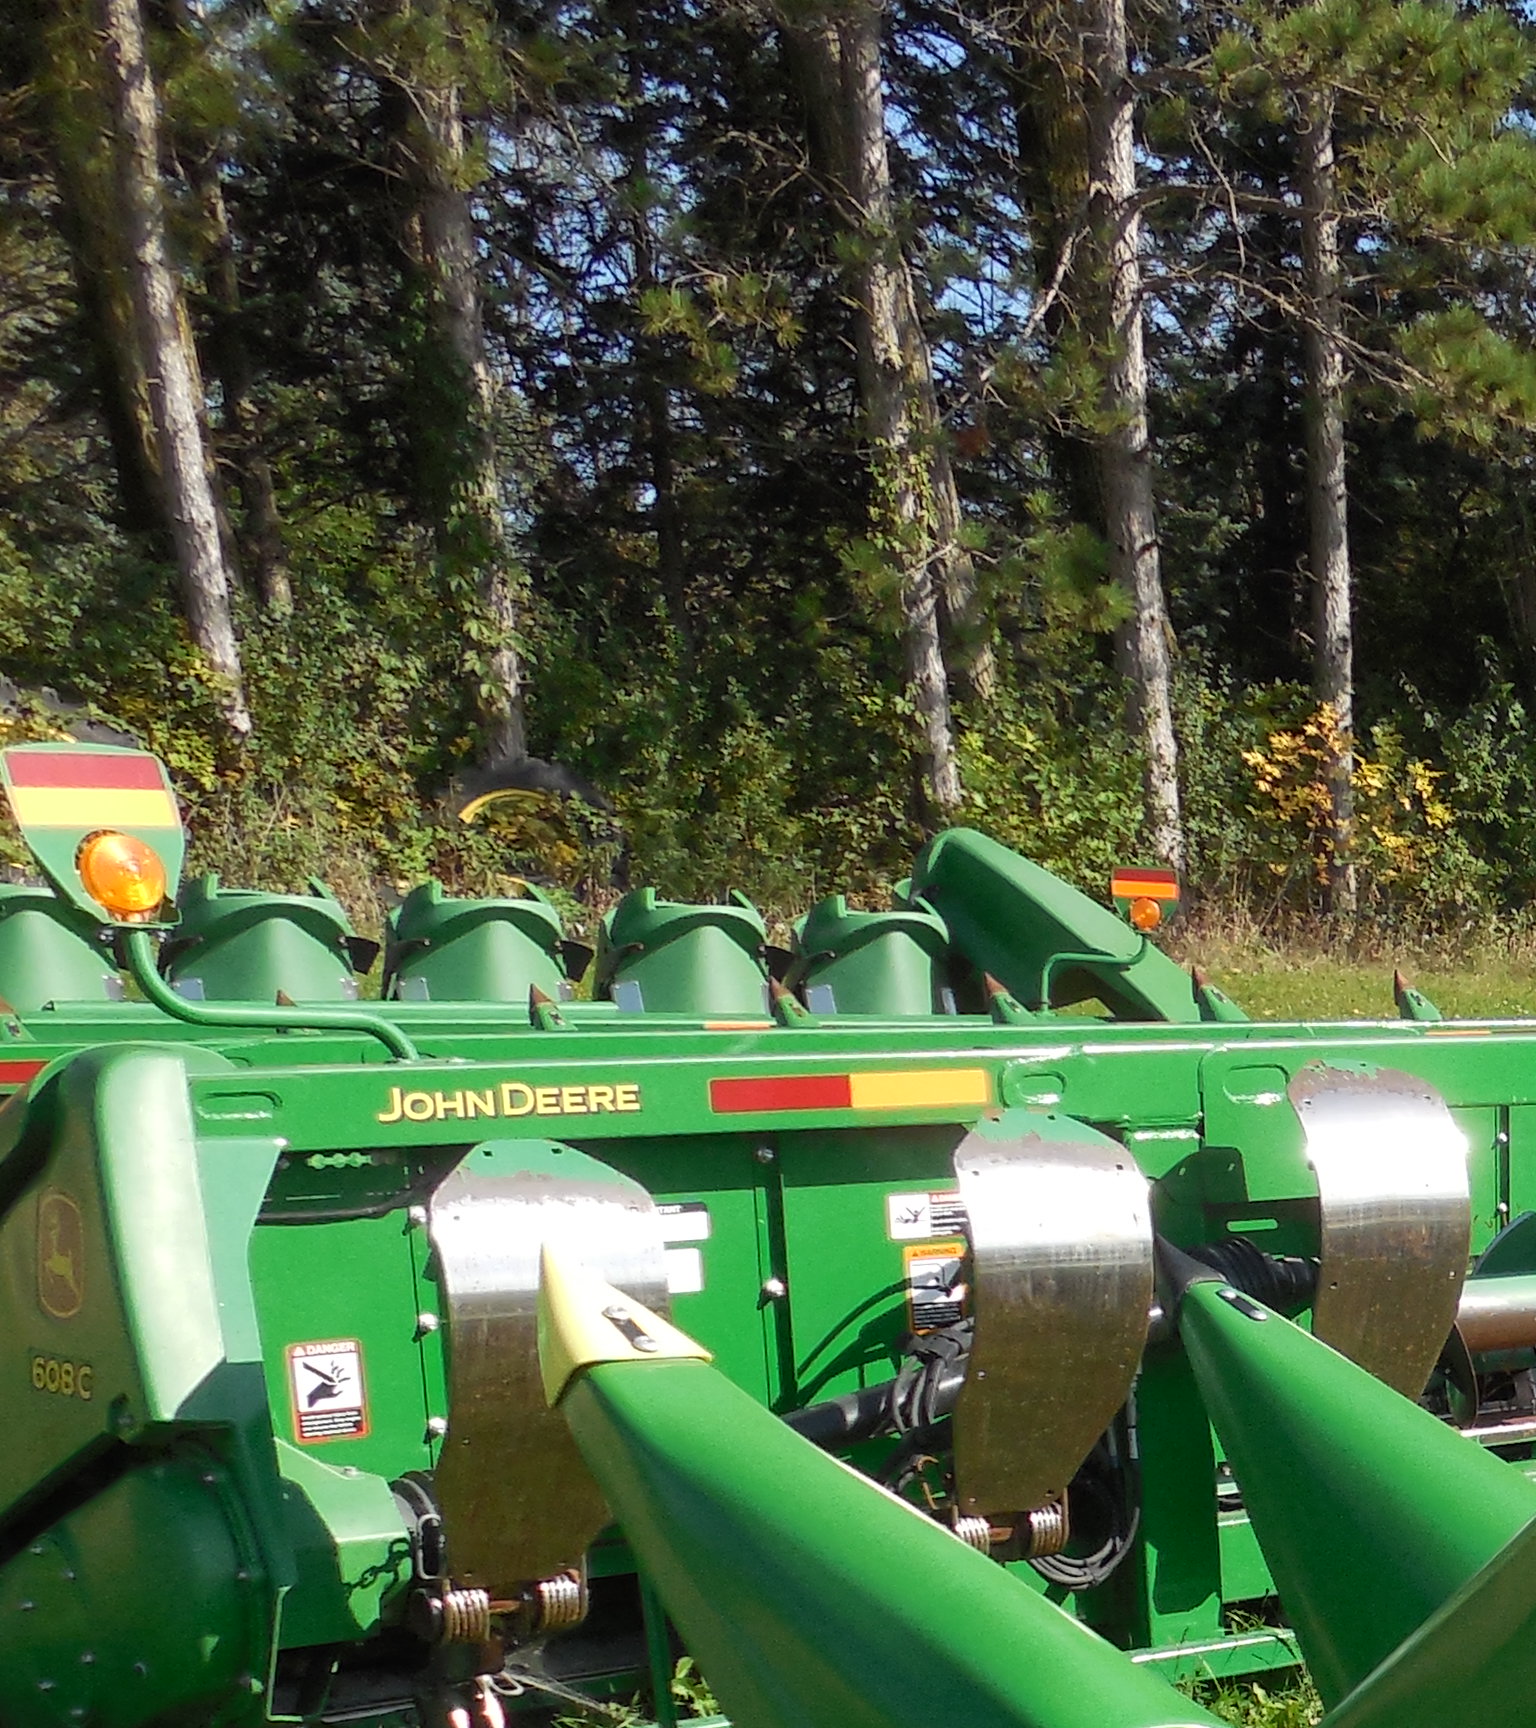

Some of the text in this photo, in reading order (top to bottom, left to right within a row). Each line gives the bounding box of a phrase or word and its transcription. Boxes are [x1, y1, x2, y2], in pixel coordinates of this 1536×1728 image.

[378, 1082, 641, 1123] JOHN DEERE
[306, 1341, 356, 1356] DANGER
[32, 1355, 93, 1401] 608C
